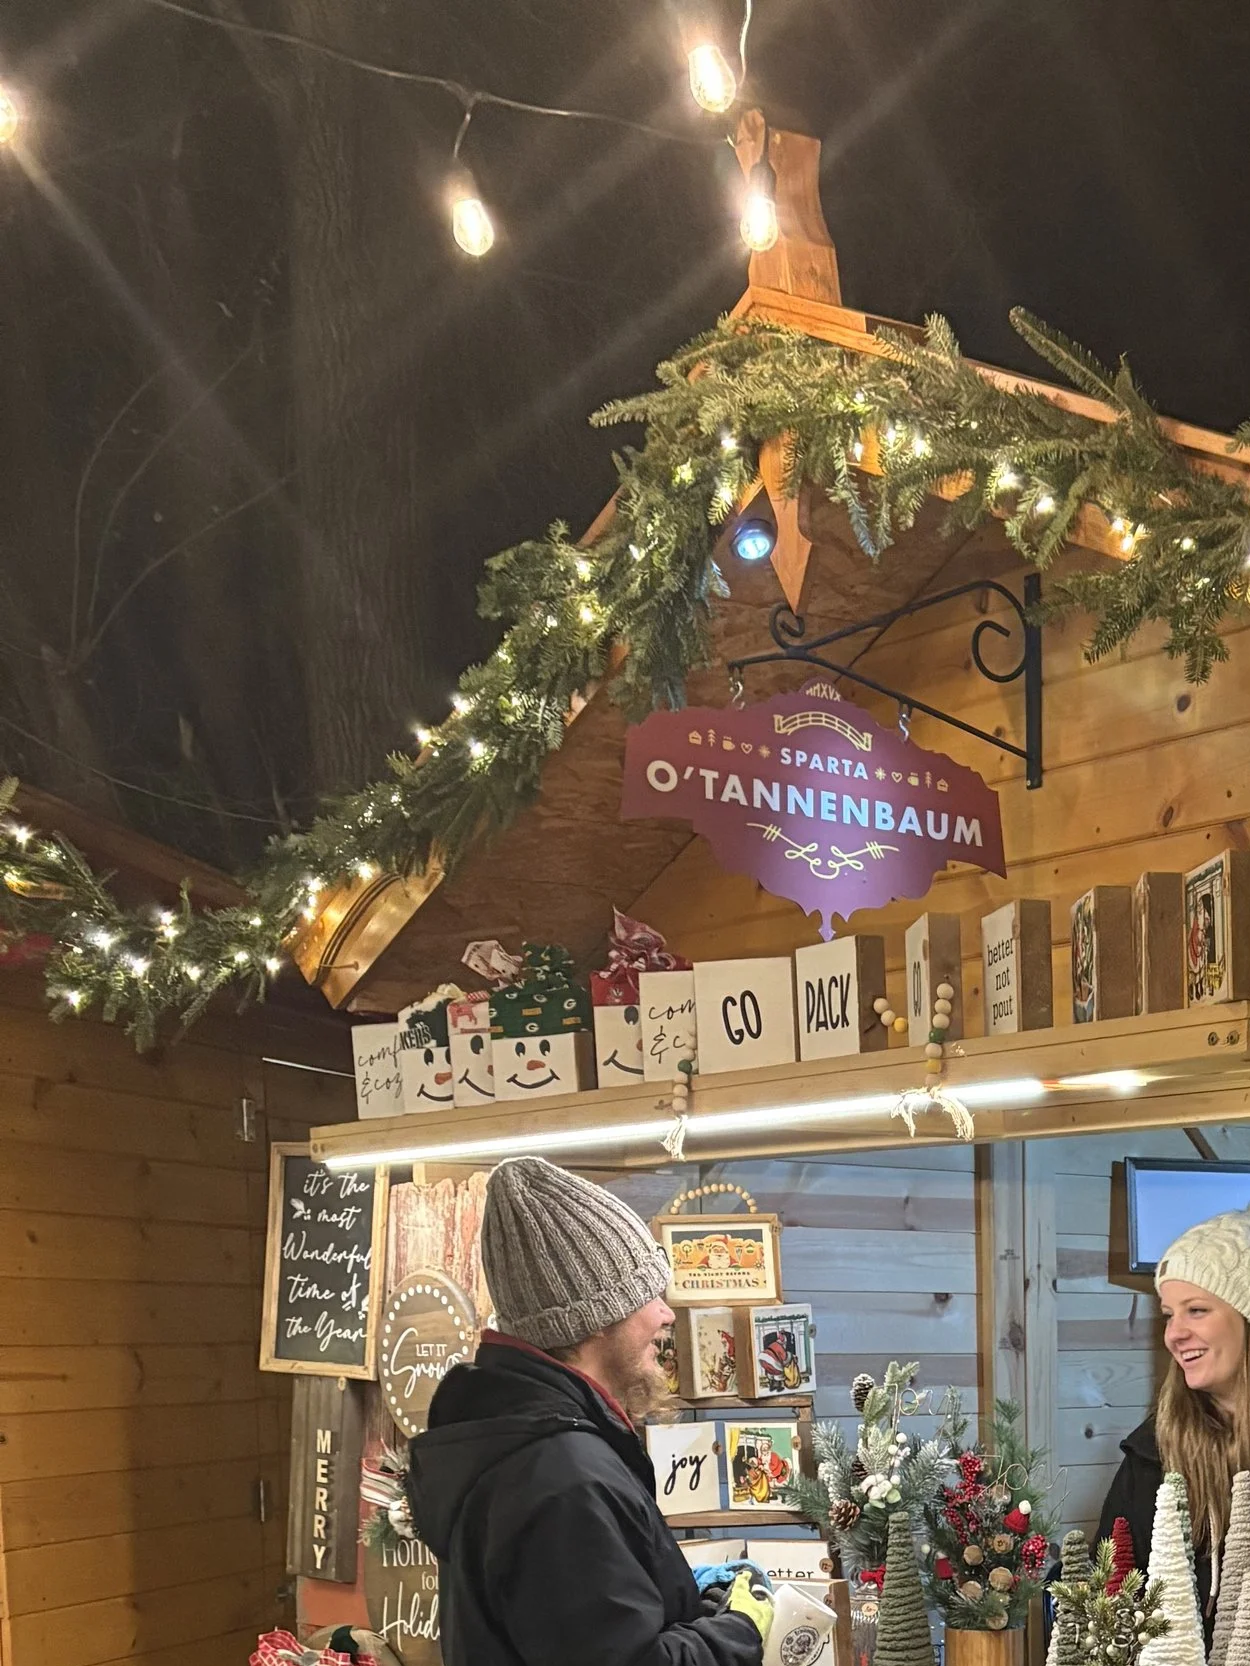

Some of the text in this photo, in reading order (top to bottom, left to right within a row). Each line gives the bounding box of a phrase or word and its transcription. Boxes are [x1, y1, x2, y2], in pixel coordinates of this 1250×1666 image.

[780, 748, 869, 780] SPARTA
[646, 760, 983, 847] O'TANNENBAUM
[987, 937, 1014, 968] better
[995, 970, 1011, 991] not
[649, 999, 696, 1020] com
[721, 989, 762, 1047] GO
[805, 972, 850, 1034] PACK
[992, 996, 1014, 1025] pout
[358, 1034, 401, 1068] comf
[650, 1025, 669, 1064] &
[374, 1072, 403, 1099] coz
[303, 1168, 370, 1199] it's the
[317, 1205, 362, 1230] most
[282, 1230, 372, 1273] Wonderful
[287, 1272, 362, 1308] time of
[682, 1278, 759, 1289] CHRISTMAS
[284, 1310, 368, 1352] the Year
[390, 1327, 464, 1399] Snow
[415, 1343, 447, 1358] LET IT
[664, 1453, 707, 1496] joy
[312, 1428, 332, 1570] MERRY
[379, 1581, 440, 1652] Holid
